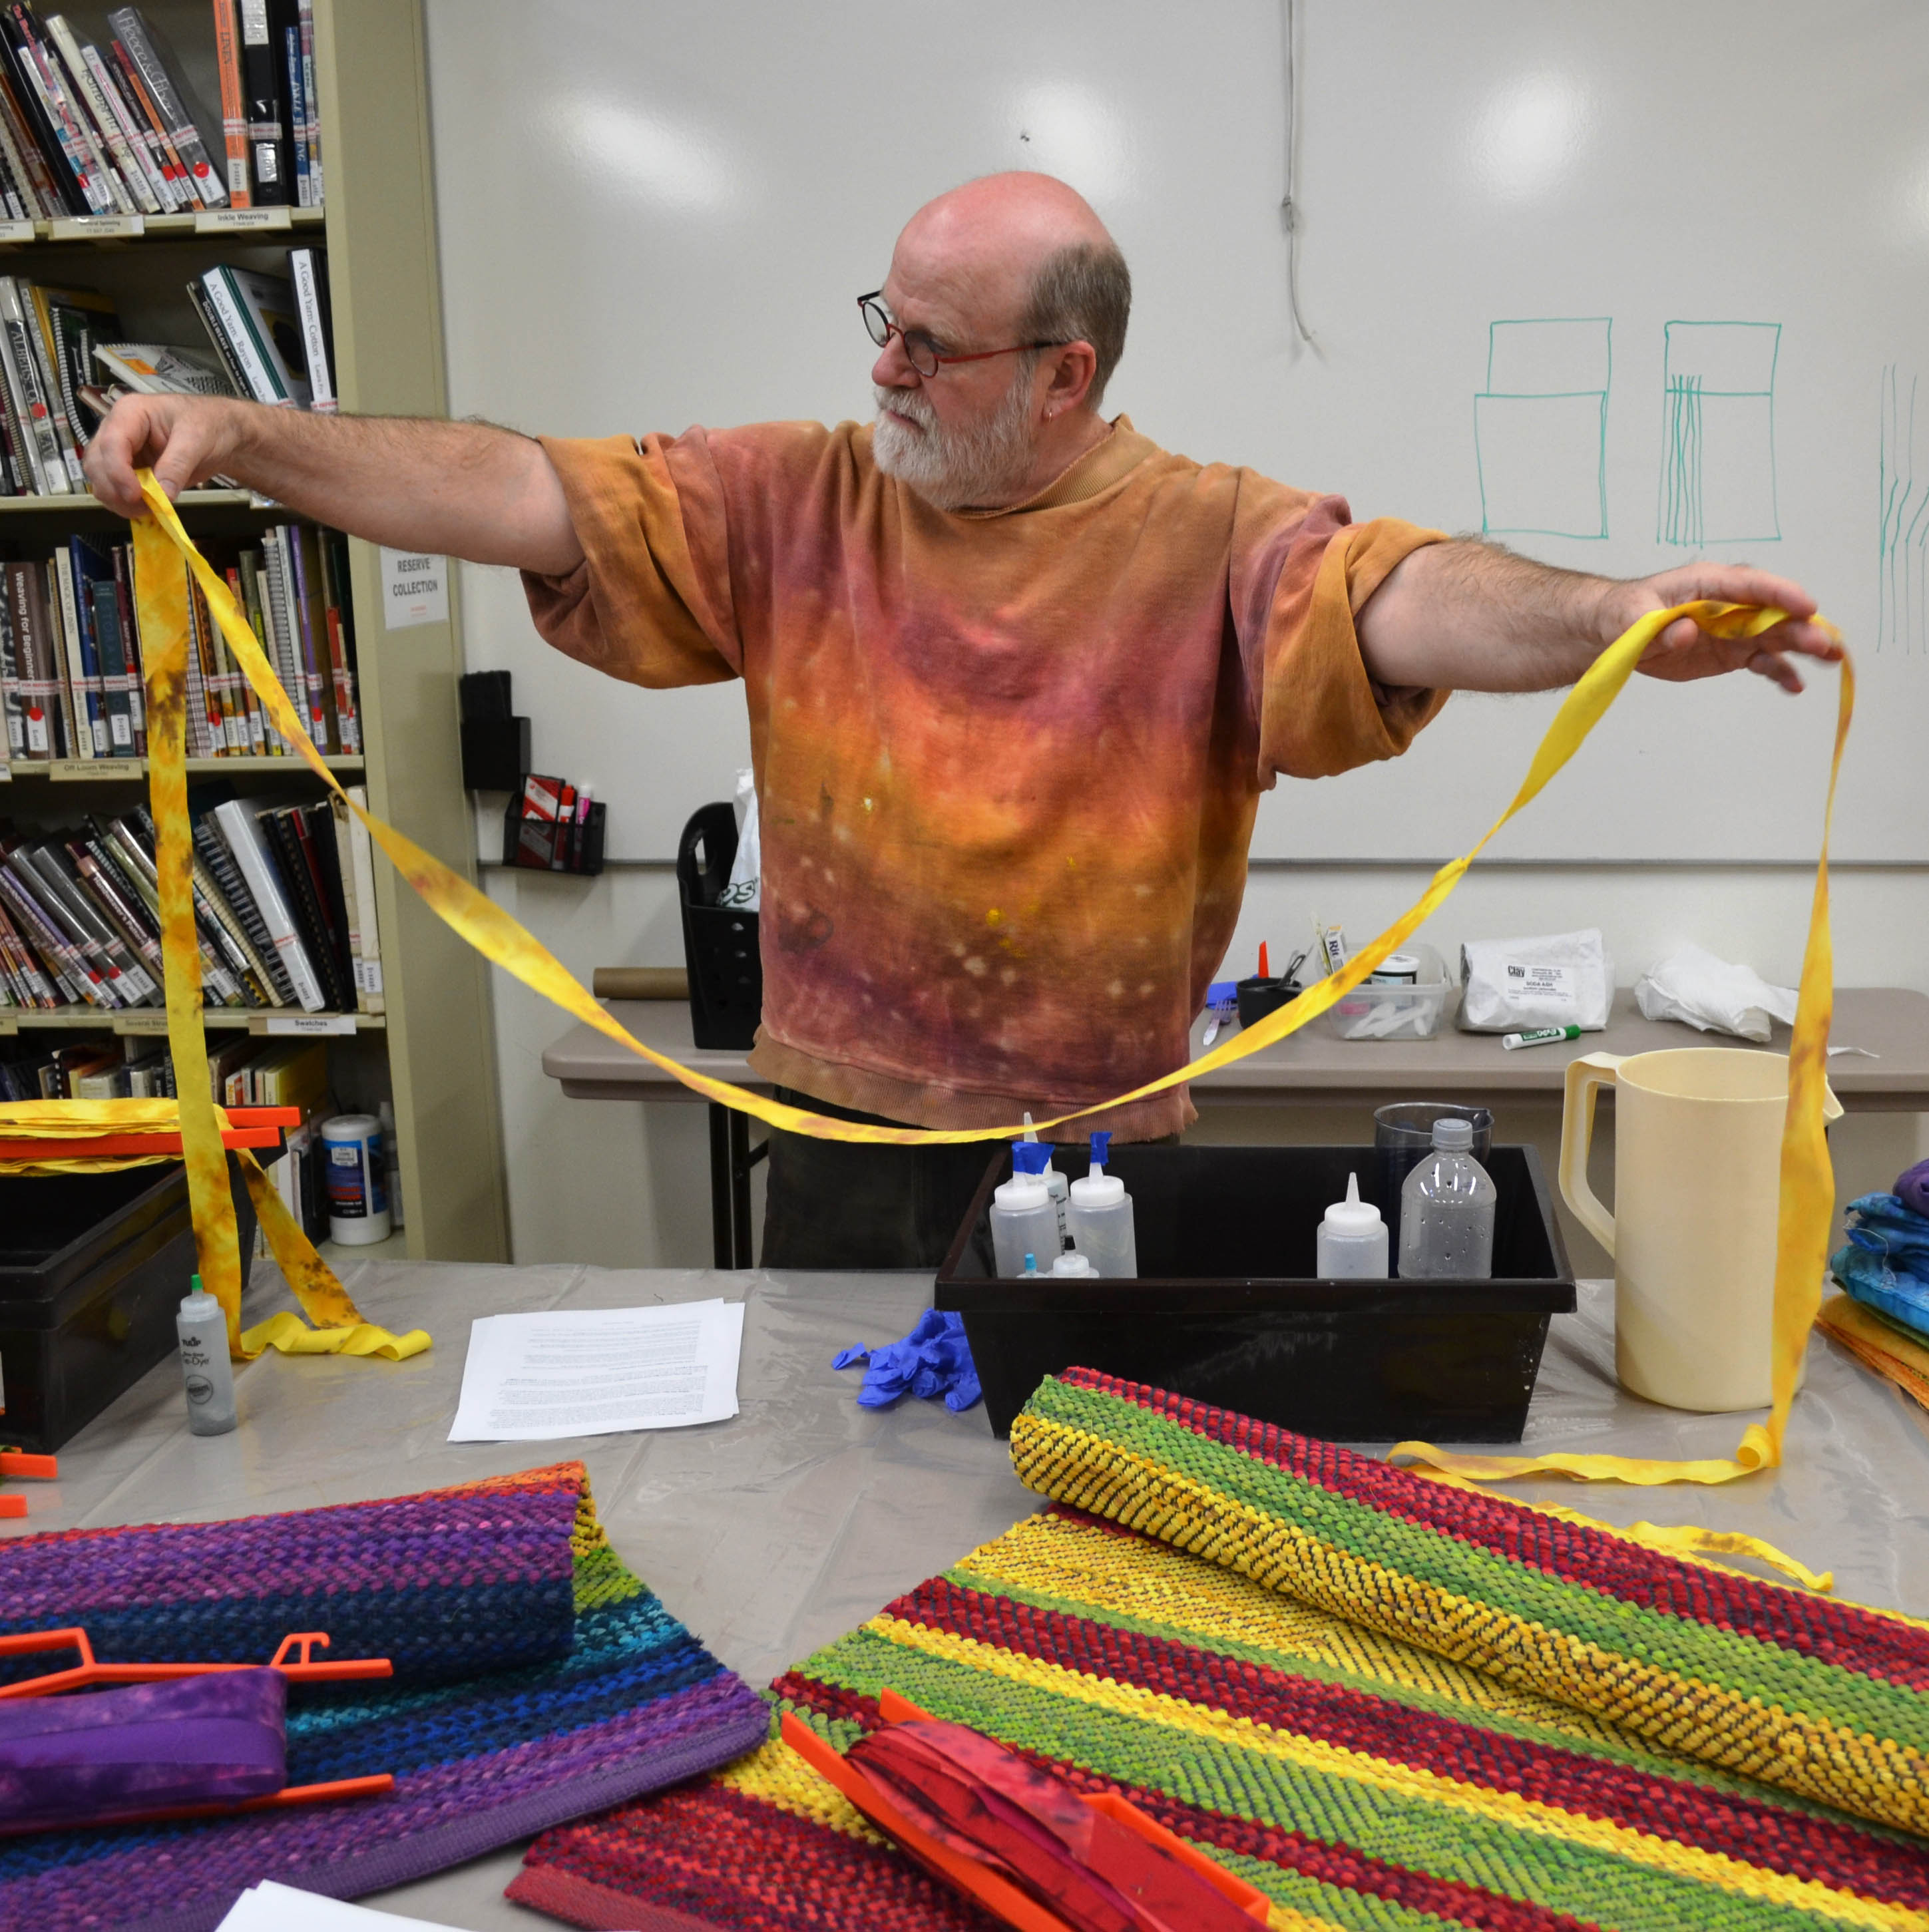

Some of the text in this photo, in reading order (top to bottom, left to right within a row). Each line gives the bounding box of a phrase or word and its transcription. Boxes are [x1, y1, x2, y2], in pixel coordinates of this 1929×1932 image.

[298, 260, 307, 270] A
[209, 282, 218, 291] A
[300, 270, 312, 296] Good
[213, 290, 230, 314] Good
[305, 298, 316, 323] Yarn:
[224, 314, 240, 337] Yarn:
[309, 324, 322, 356] Cotton
[234, 339, 255, 369] Rayon
[397, 558, 431, 572] RESERVE
[393, 579, 438, 596] COLLECTION
[15, 572, 37, 682] Weaving for Beginner
[1329, 940, 1340, 957] Rit
[1508, 965, 1525, 977] Clay
